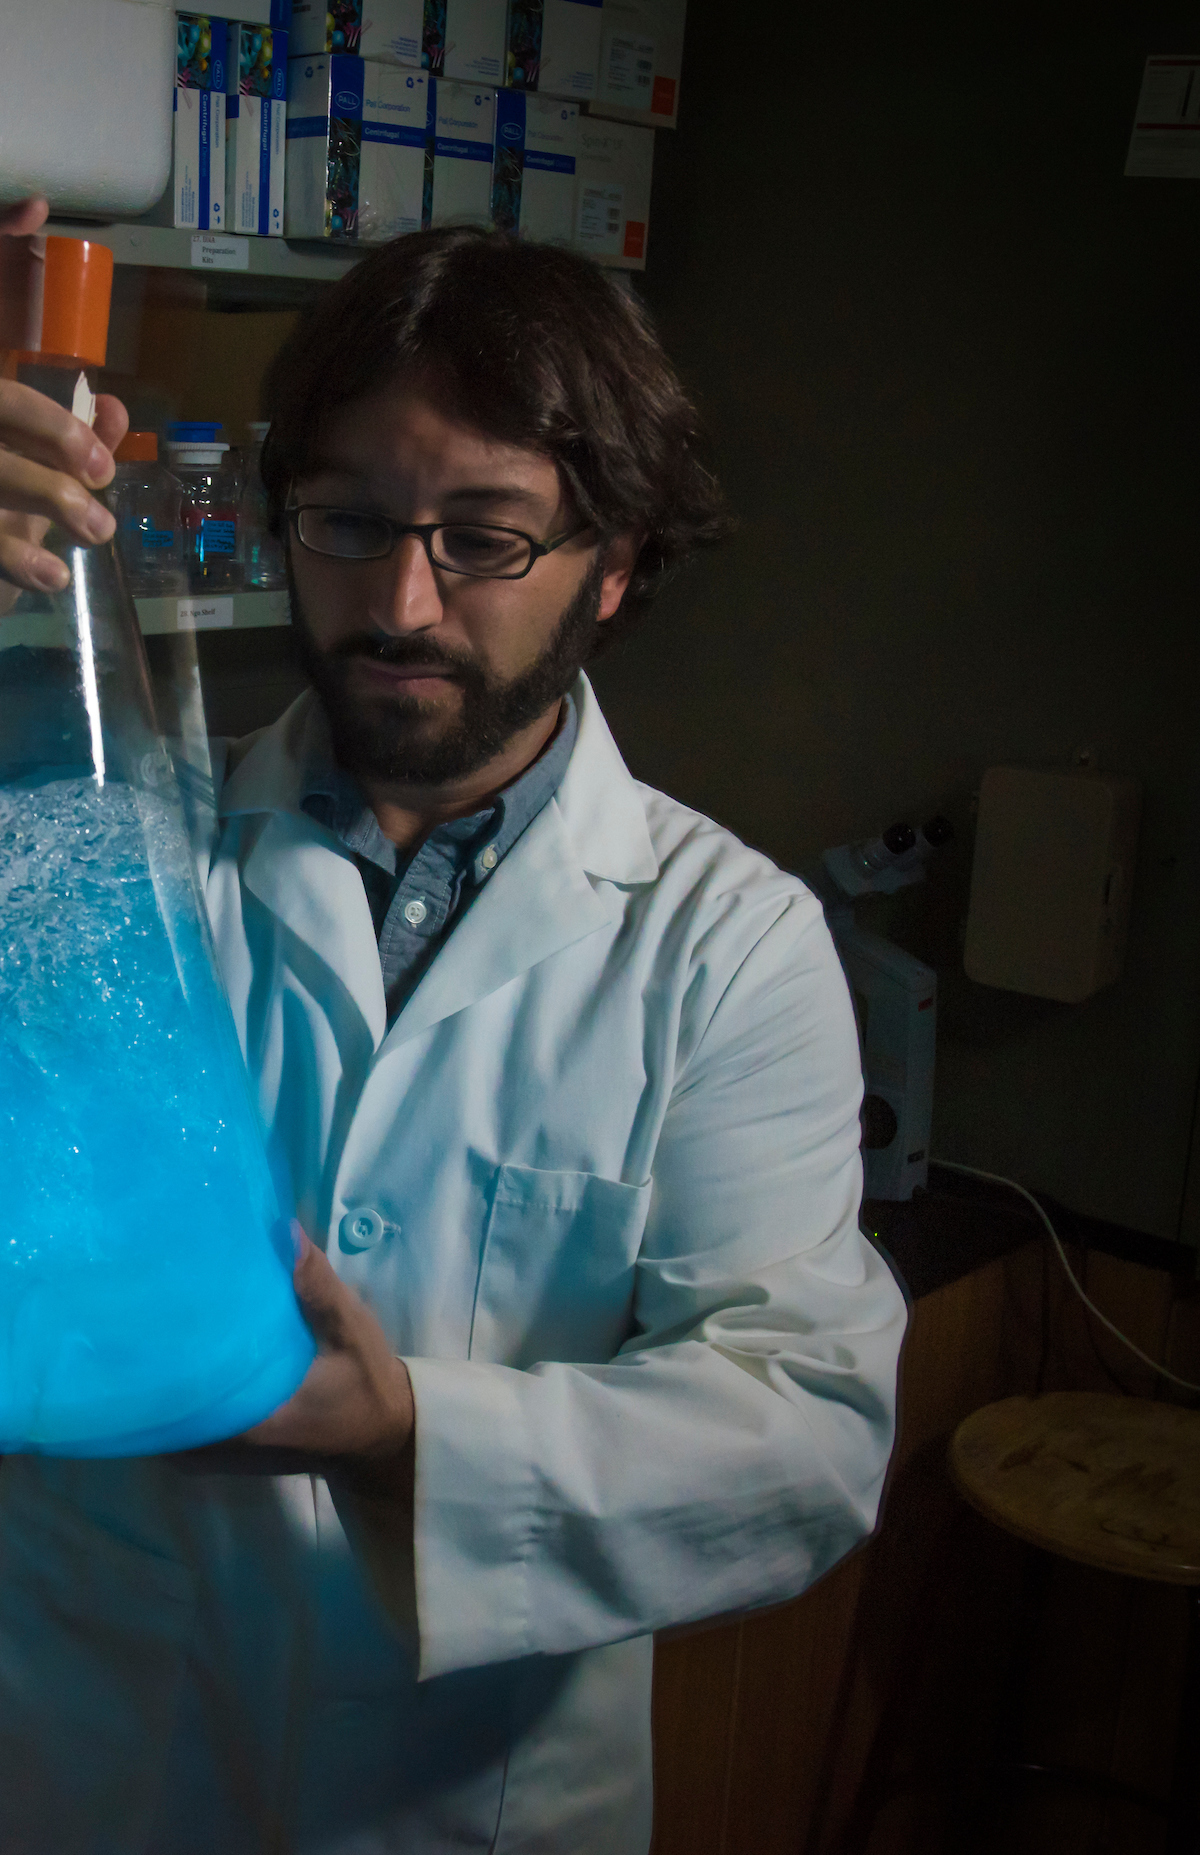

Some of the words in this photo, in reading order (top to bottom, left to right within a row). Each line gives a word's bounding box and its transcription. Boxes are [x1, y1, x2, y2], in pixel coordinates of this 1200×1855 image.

[338, 95, 356, 105] PALL
[366, 100, 377, 108] Pall
[378, 101, 410, 112] Corporation
[365, 127, 400, 139] Centrifugal
[504, 127, 520, 136] PALL
[437, 142, 468, 153] Centrifugal
[526, 155, 554, 166] Centrifugal
[202, 246, 236, 255] Preparation
